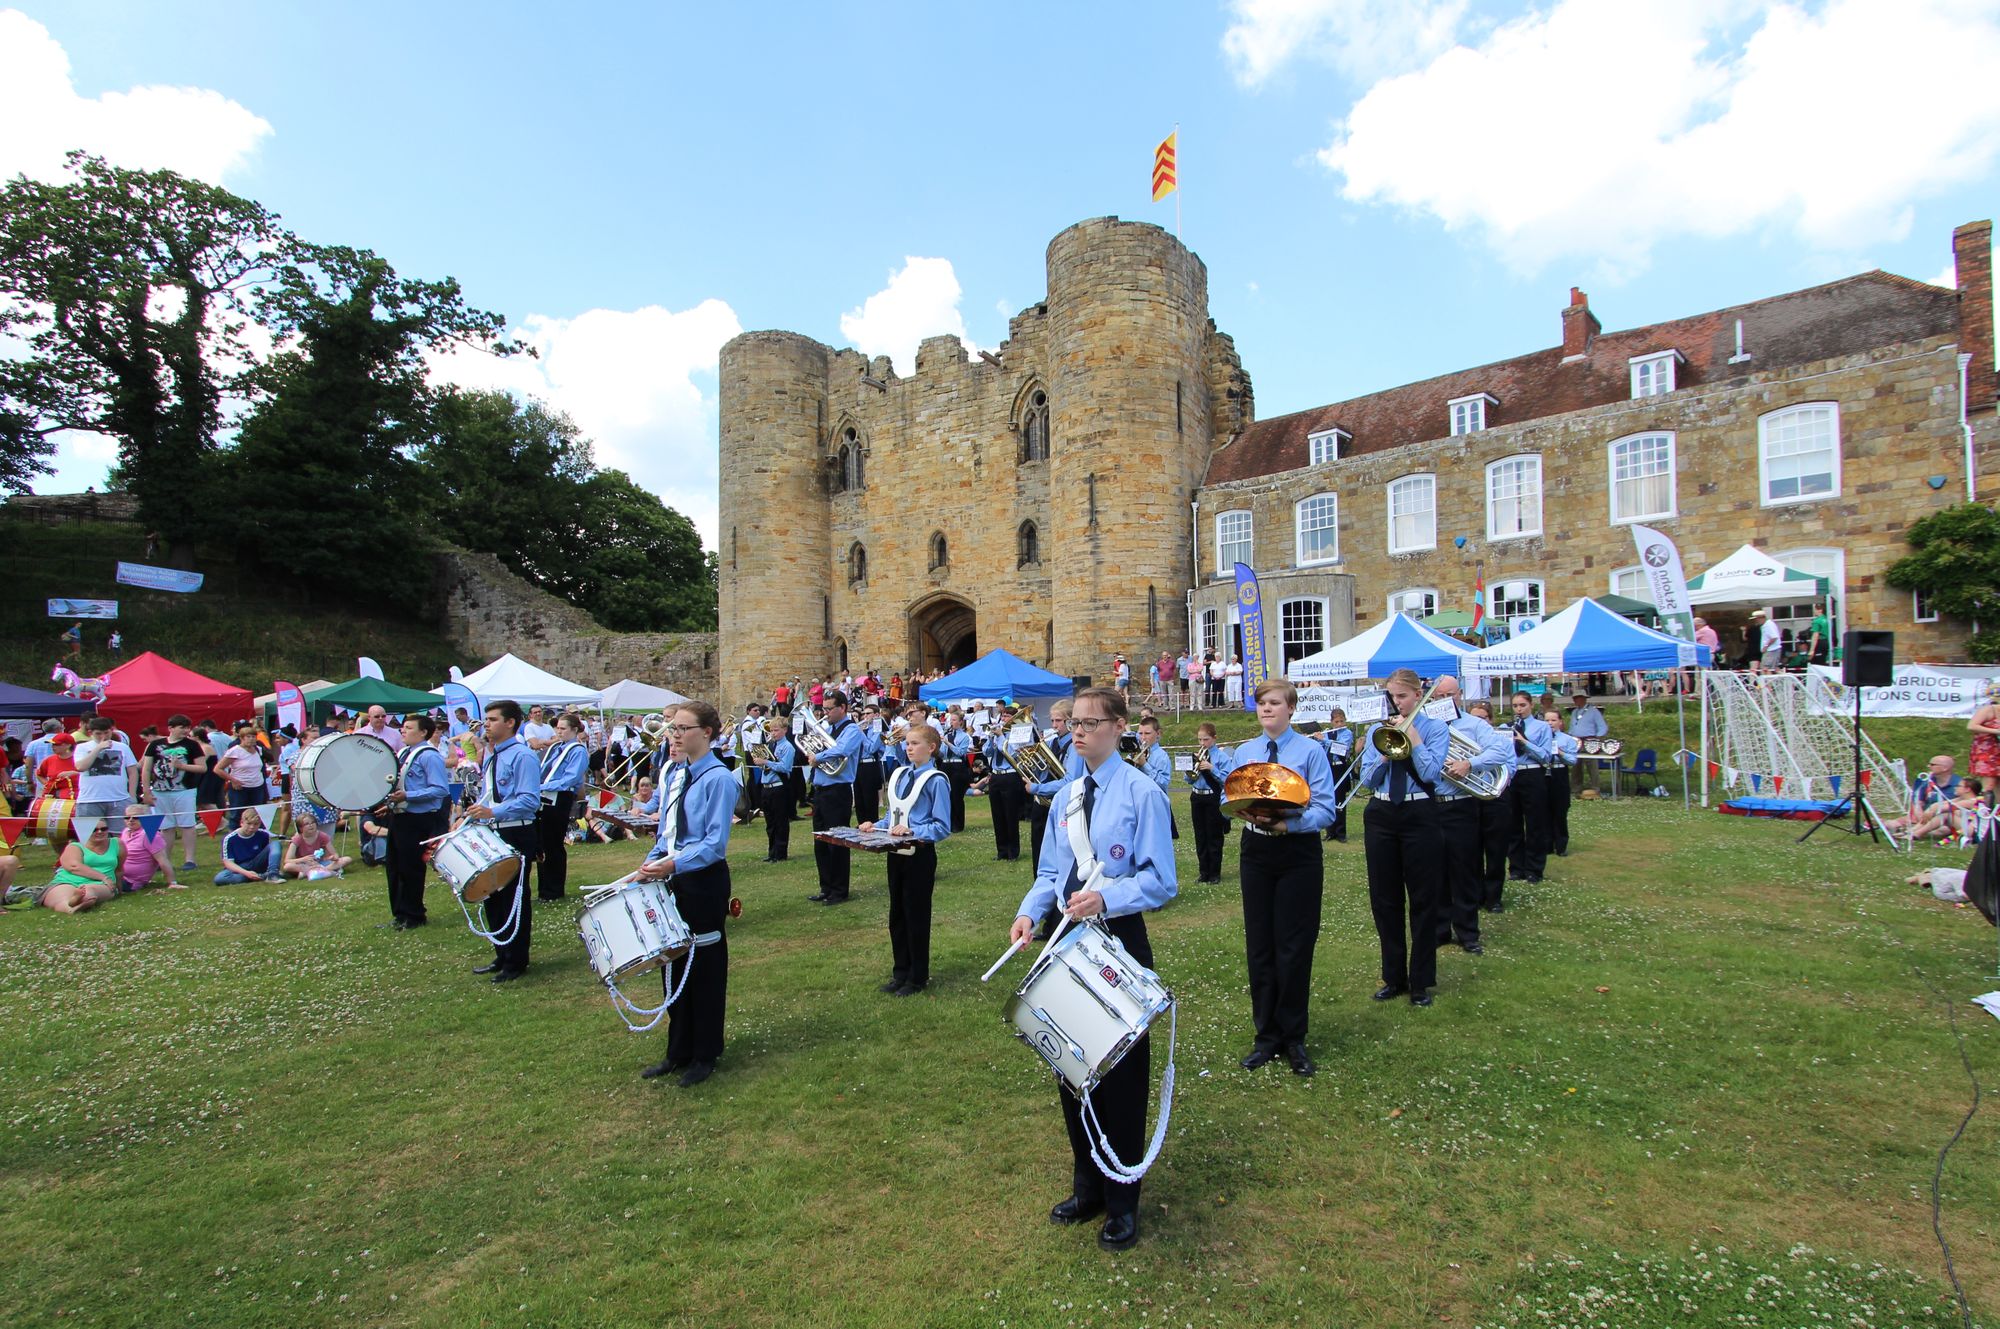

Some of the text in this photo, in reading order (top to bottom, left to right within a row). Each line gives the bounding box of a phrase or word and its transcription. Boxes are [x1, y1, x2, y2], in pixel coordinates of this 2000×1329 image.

[1243, 613, 1254, 655] LIONS
[1479, 652, 1542, 662] Tonbridge
[1513, 661, 1542, 670] Club
[1329, 667, 1353, 675] Club
[1298, 694, 1341, 703] ONBRIDGE
[1867, 691, 1961, 702] LIONS CLUB
[356, 739, 384, 754] Premier
[1040, 1034, 1057, 1056] 17
